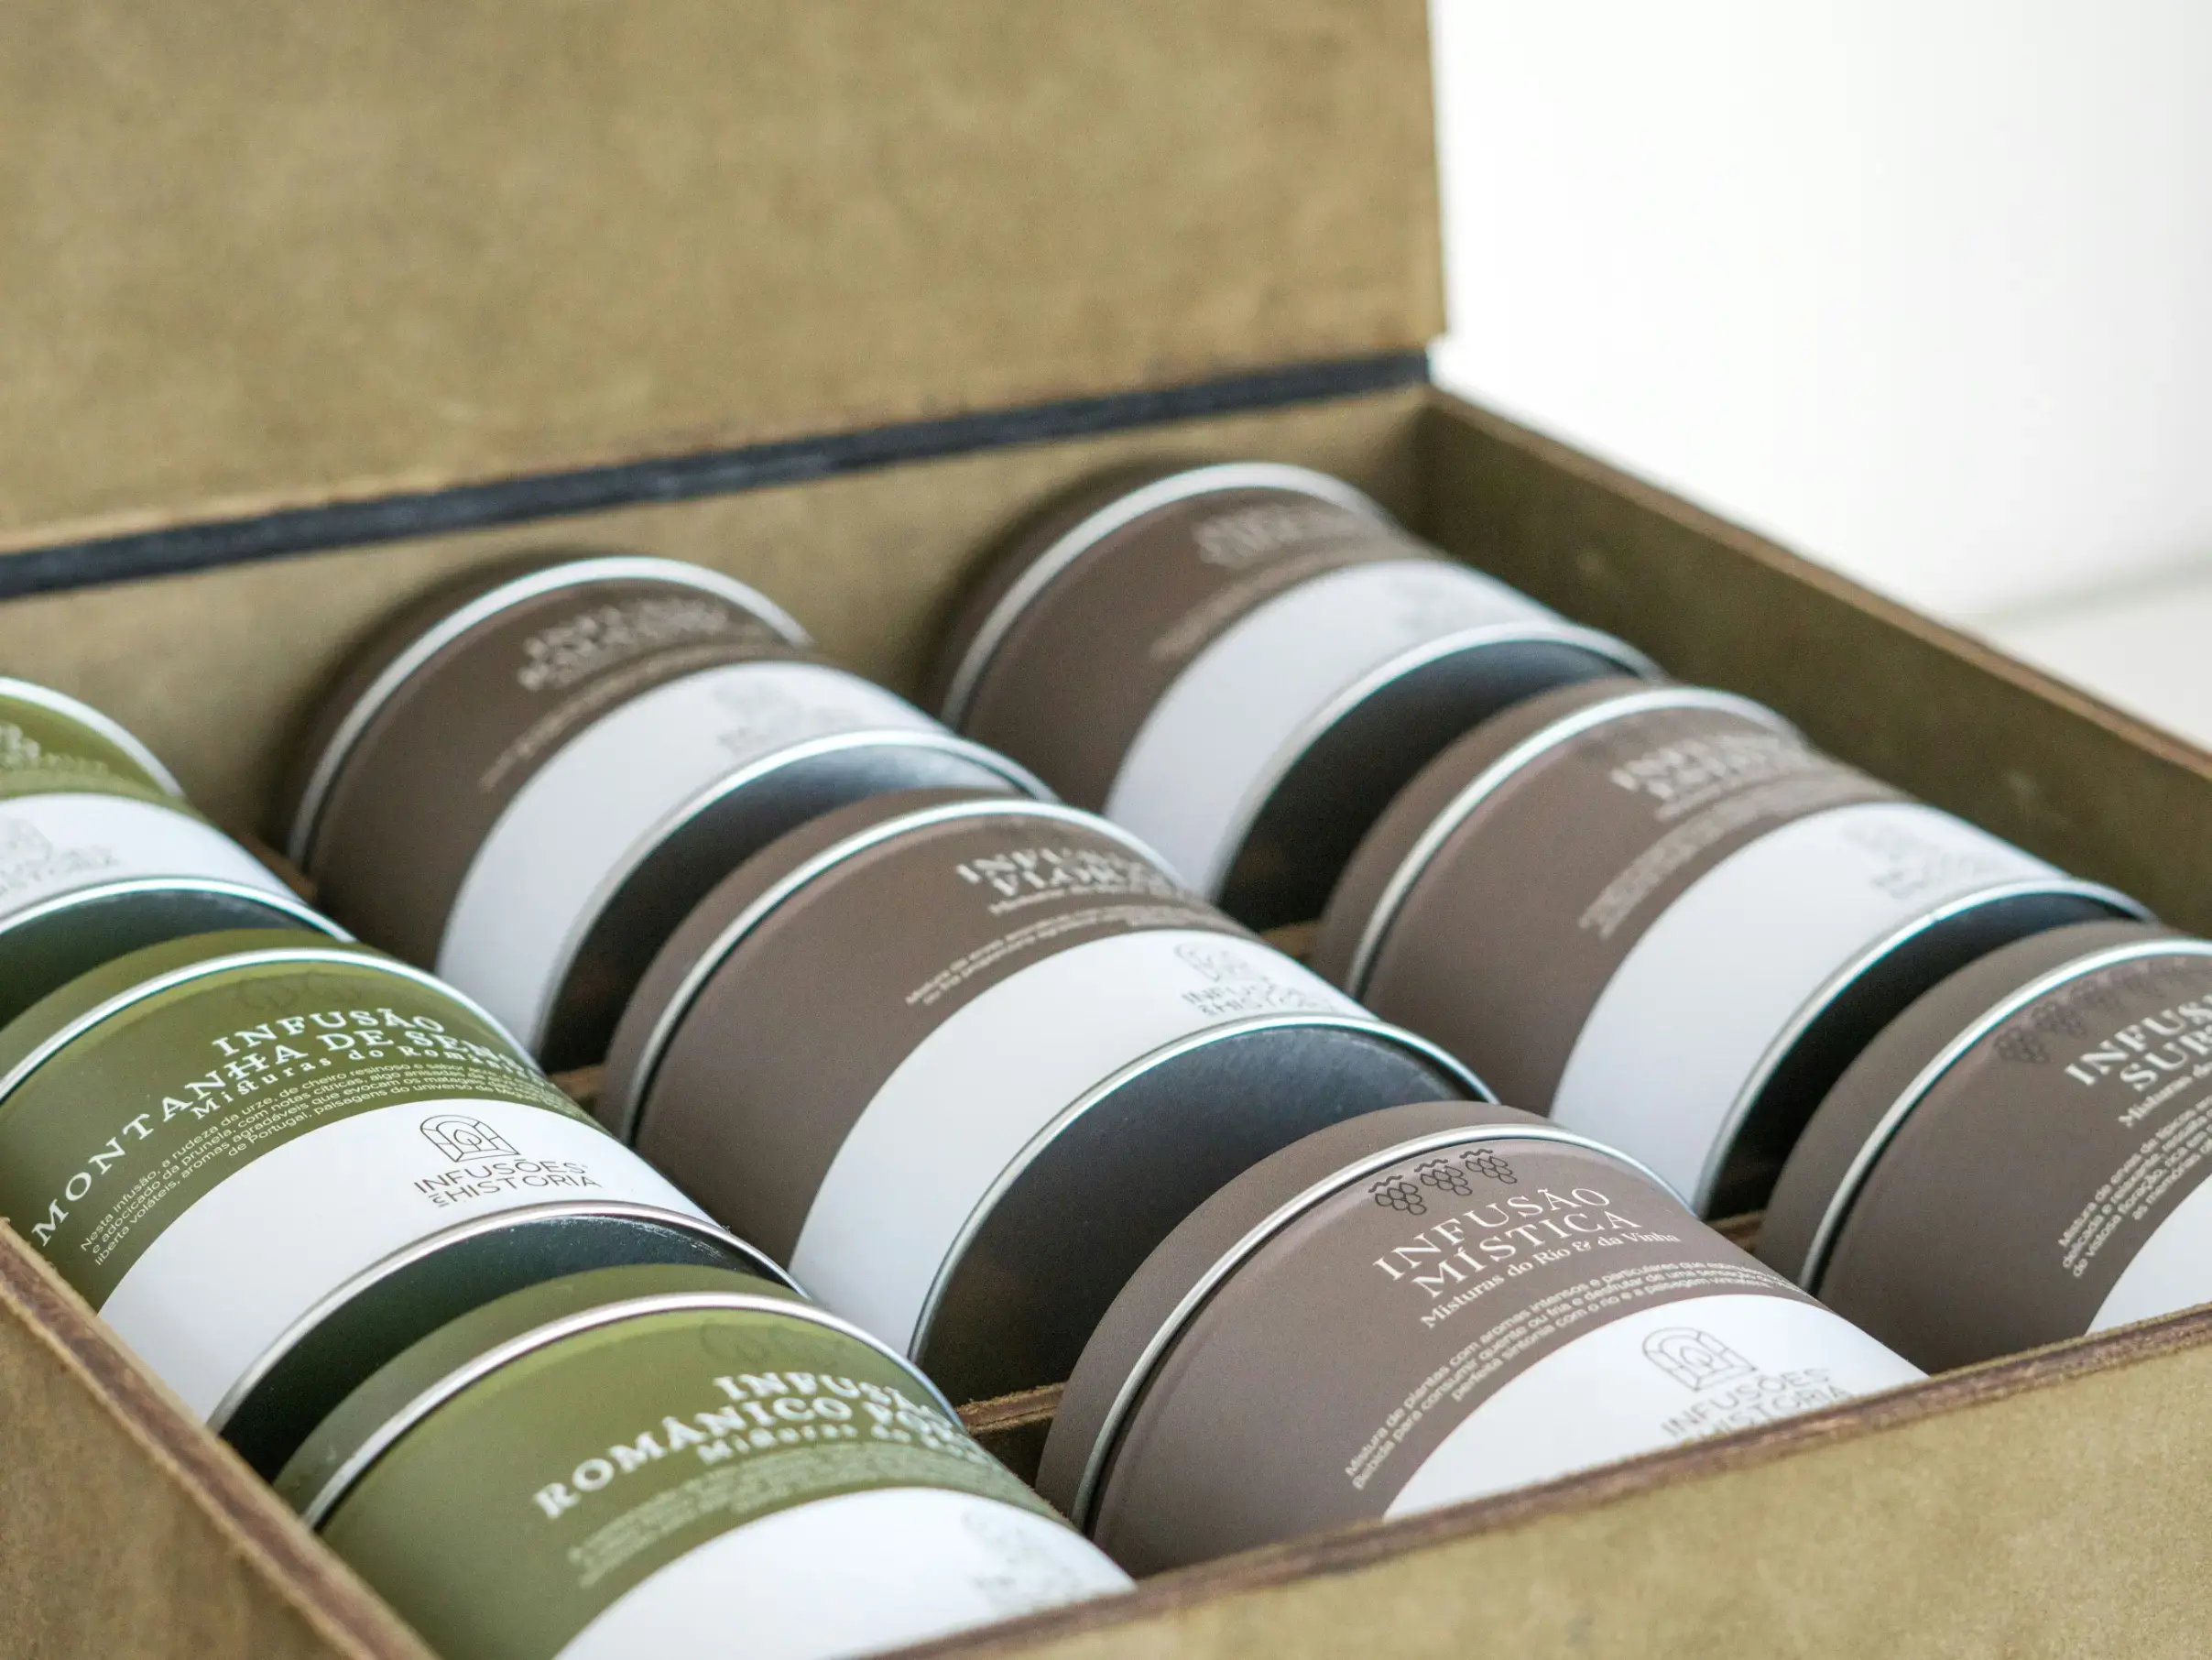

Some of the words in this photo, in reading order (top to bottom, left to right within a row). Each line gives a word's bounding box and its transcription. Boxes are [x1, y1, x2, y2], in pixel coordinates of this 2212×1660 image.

[212, 1008, 445, 1056] INFUSÃO
[2065, 995, 2212, 1086] INFUS
[191, 1057, 332, 1119] Misturas
[348, 1049, 384, 1060] do
[228, 1142, 247, 1156] de
[313, 1088, 388, 1115] paisagens
[390, 1085, 410, 1094] do
[31, 1042, 309, 1247] MONTANHA
[316, 1030, 395, 1051] DE
[81, 1213, 114, 1251] Nesta
[161, 1159, 171, 1169] a
[172, 1126, 219, 1160] rudeza
[221, 1113, 241, 1127] da
[279, 1087, 299, 1098] de
[301, 1071, 347, 1090] cheiro
[349, 1063, 411, 1077] resinoso
[93, 1246, 101, 1254] e
[103, 1181, 161, 1243] adocicado
[162, 1165, 180, 1180] da
[237, 1109, 269, 1129] com
[270, 1090, 311, 1112] notas
[94, 1227, 131, 1266] liberta
[181, 1141, 231, 1179] aromas
[232, 1101, 310, 1144] agradáveis
[311, 1090, 342, 1107] que
[343, 1079, 401, 1097] evocam
[1373, 1188, 1609, 1281] INFUSÃO
[1412, 1208, 1642, 1298] MÍSTICA
[1421, 1274, 1506, 1328] Misturas
[1507, 1261, 1533, 1278] do
[1533, 1244, 1572, 1265] Rio
[1572, 1240, 1593, 1252] &
[1597, 1236, 1624, 1248] da
[1620, 1231, 1682, 1244] Vinha
[1449, 1341, 1481, 1366] com
[1527, 1313, 1549, 1328] ou
[1555, 1308, 1587, 1327] com
